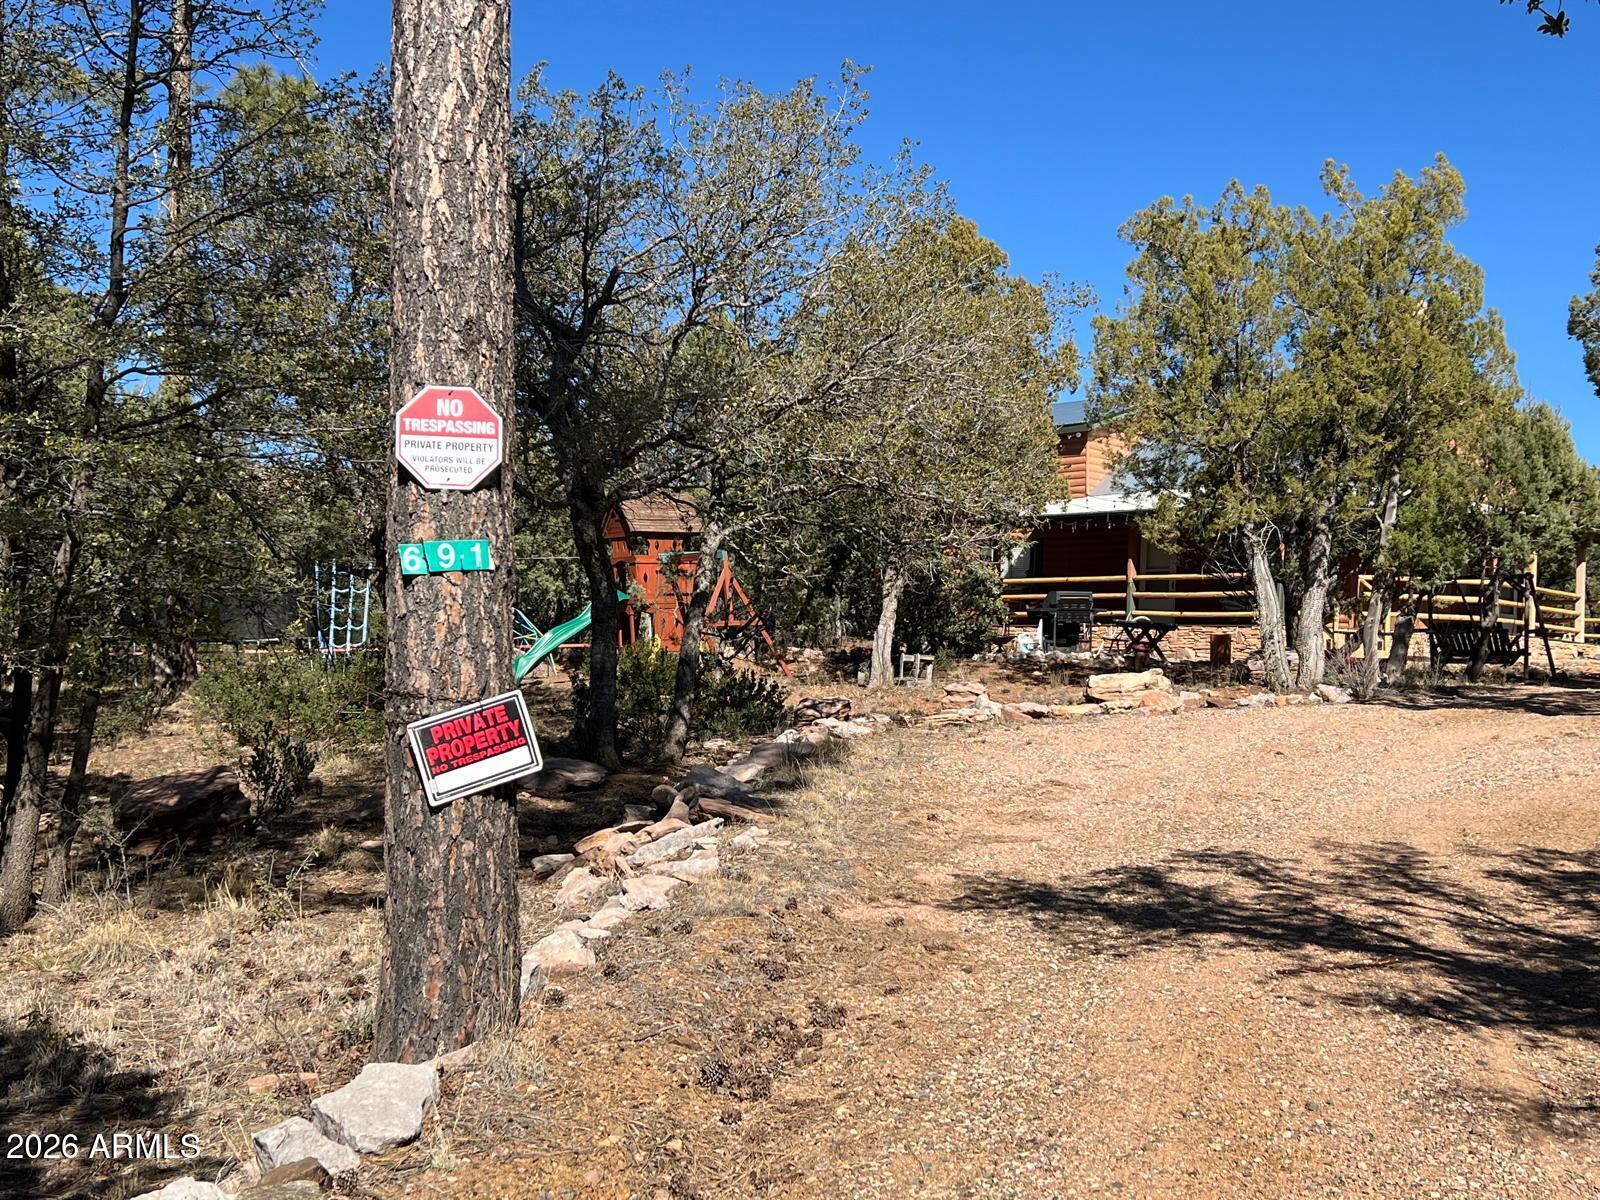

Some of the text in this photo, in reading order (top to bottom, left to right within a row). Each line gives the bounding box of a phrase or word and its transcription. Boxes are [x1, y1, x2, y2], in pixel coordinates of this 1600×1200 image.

[436, 398, 464, 417] NO
[403, 418, 496, 435] TRESPASSING
[404, 440, 494, 452] PRIVATE PROPERTY
[412, 455, 453, 464] VIOLATORS
[456, 457, 473, 465] WILL
[424, 465, 473, 474] PROSECUTED
[402, 542, 482, 572] 691
[430, 704, 509, 744] PRIVATE
[425, 719, 520, 766] PROPERTY
[431, 737, 526, 775] NO TRESPASSING
